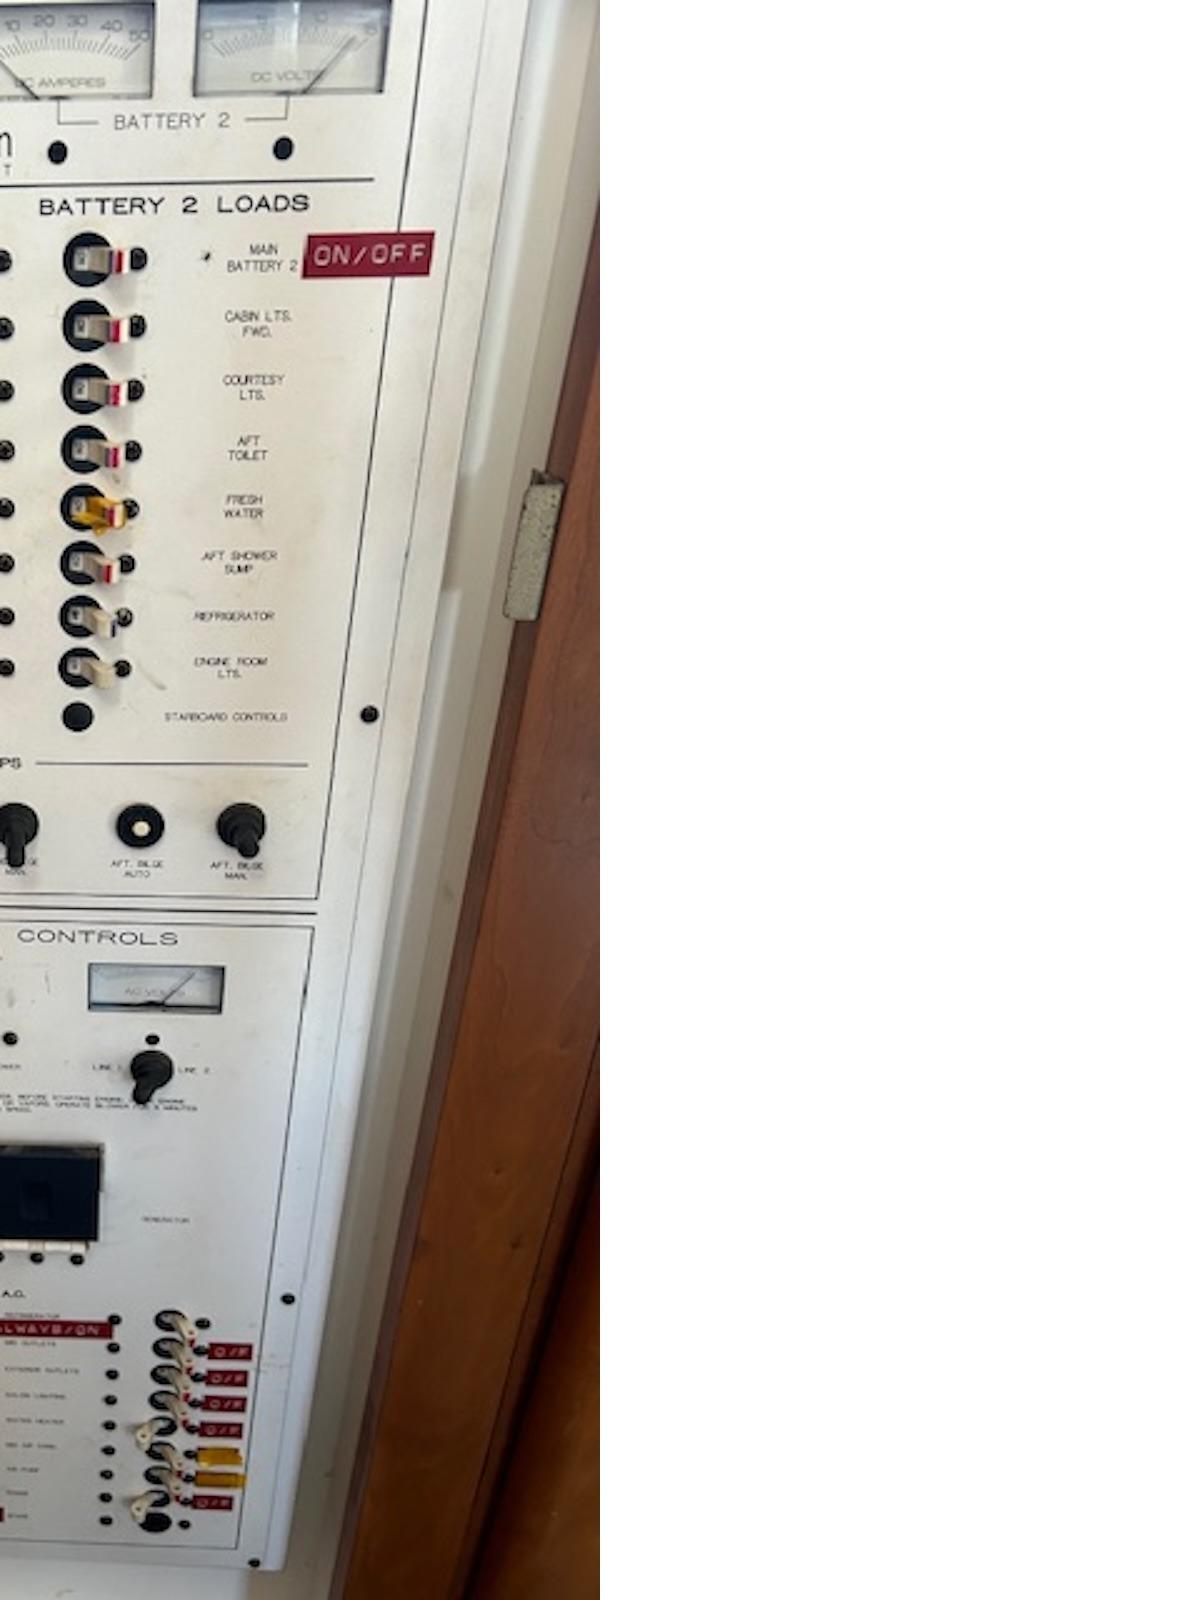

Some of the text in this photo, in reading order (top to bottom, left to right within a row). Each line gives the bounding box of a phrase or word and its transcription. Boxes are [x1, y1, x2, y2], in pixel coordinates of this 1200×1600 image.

[4, 19, 21, 33] 10
[33, 14, 55, 28] 20
[67, 14, 88, 28] 30
[101, 19, 123, 33] 40
[129, 29, 150, 43] 50
[38, 77, 106, 89] AMPERES
[252, 71, 272, 83] DC
[113, 112, 231, 131] BATTERY 2
[38, 194, 311, 217] BATTERY 2 LOADS
[248, 243, 279, 257] MAIN
[312, 243, 428, 268] ON/OFF
[226, 259, 299, 274] BATTERY 2
[224, 310, 291, 323] CABIN LTS.
[222, 374, 285, 387] COURTESY
[239, 389, 266, 401] LTS.
[237, 435, 261, 447] AFT
[228, 449, 269, 461] TOILET
[225, 494, 263, 506] FRESH
[223, 508, 264, 519] WATER
[201, 550, 279, 562] AFT SHOWER
[224, 563, 254, 574] SUMP
[193, 611, 276, 622] REFRIGERATOR
[194, 656, 269, 668] ENGINE ROOM
[164, 711, 289, 723] STARBOARD CONTROLS
[16, 929, 180, 946] CONTROLS
